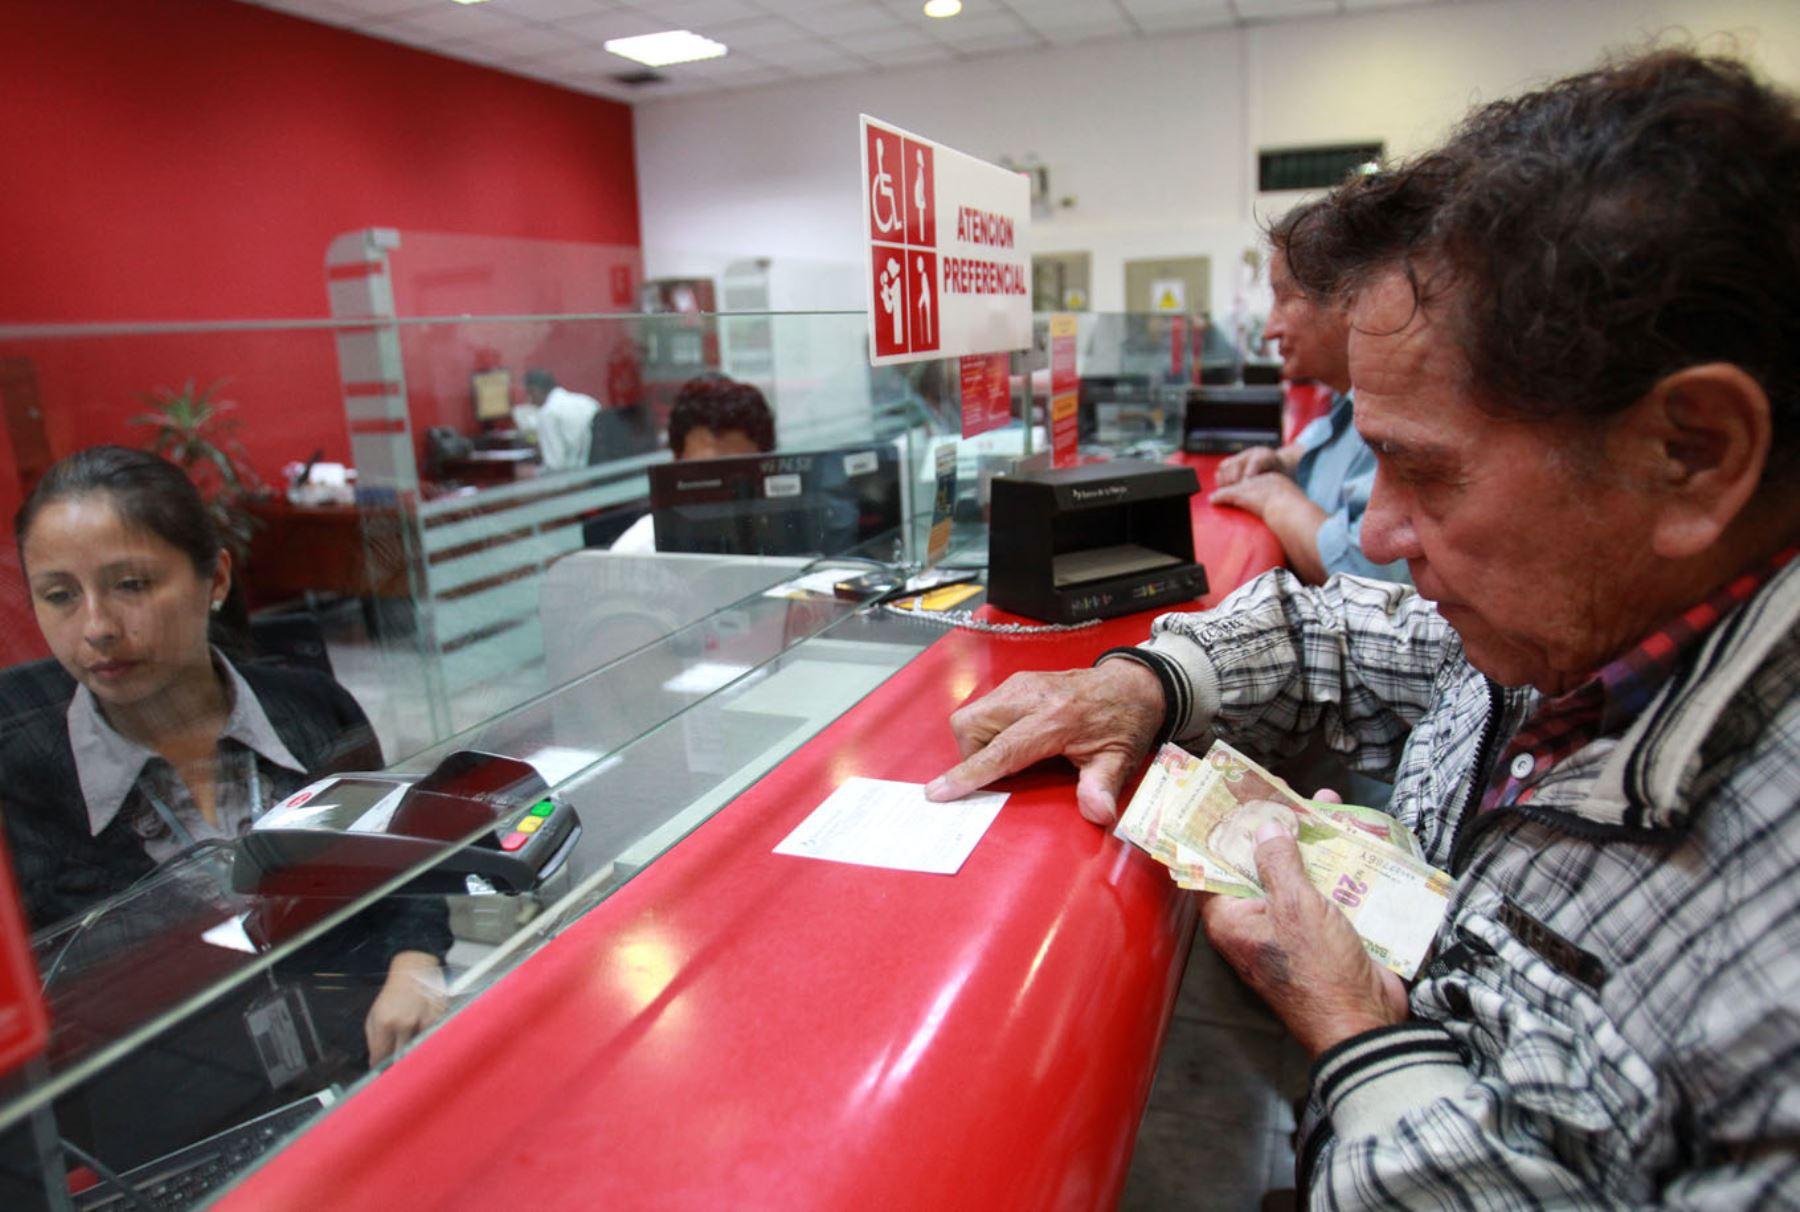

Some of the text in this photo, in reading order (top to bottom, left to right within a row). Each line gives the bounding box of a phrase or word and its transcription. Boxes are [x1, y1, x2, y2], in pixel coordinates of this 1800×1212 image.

[957, 205, 1015, 249] ATENCION
[942, 256, 1027, 296] PREFERENCIAL
[1332, 873, 1369, 908] 20
